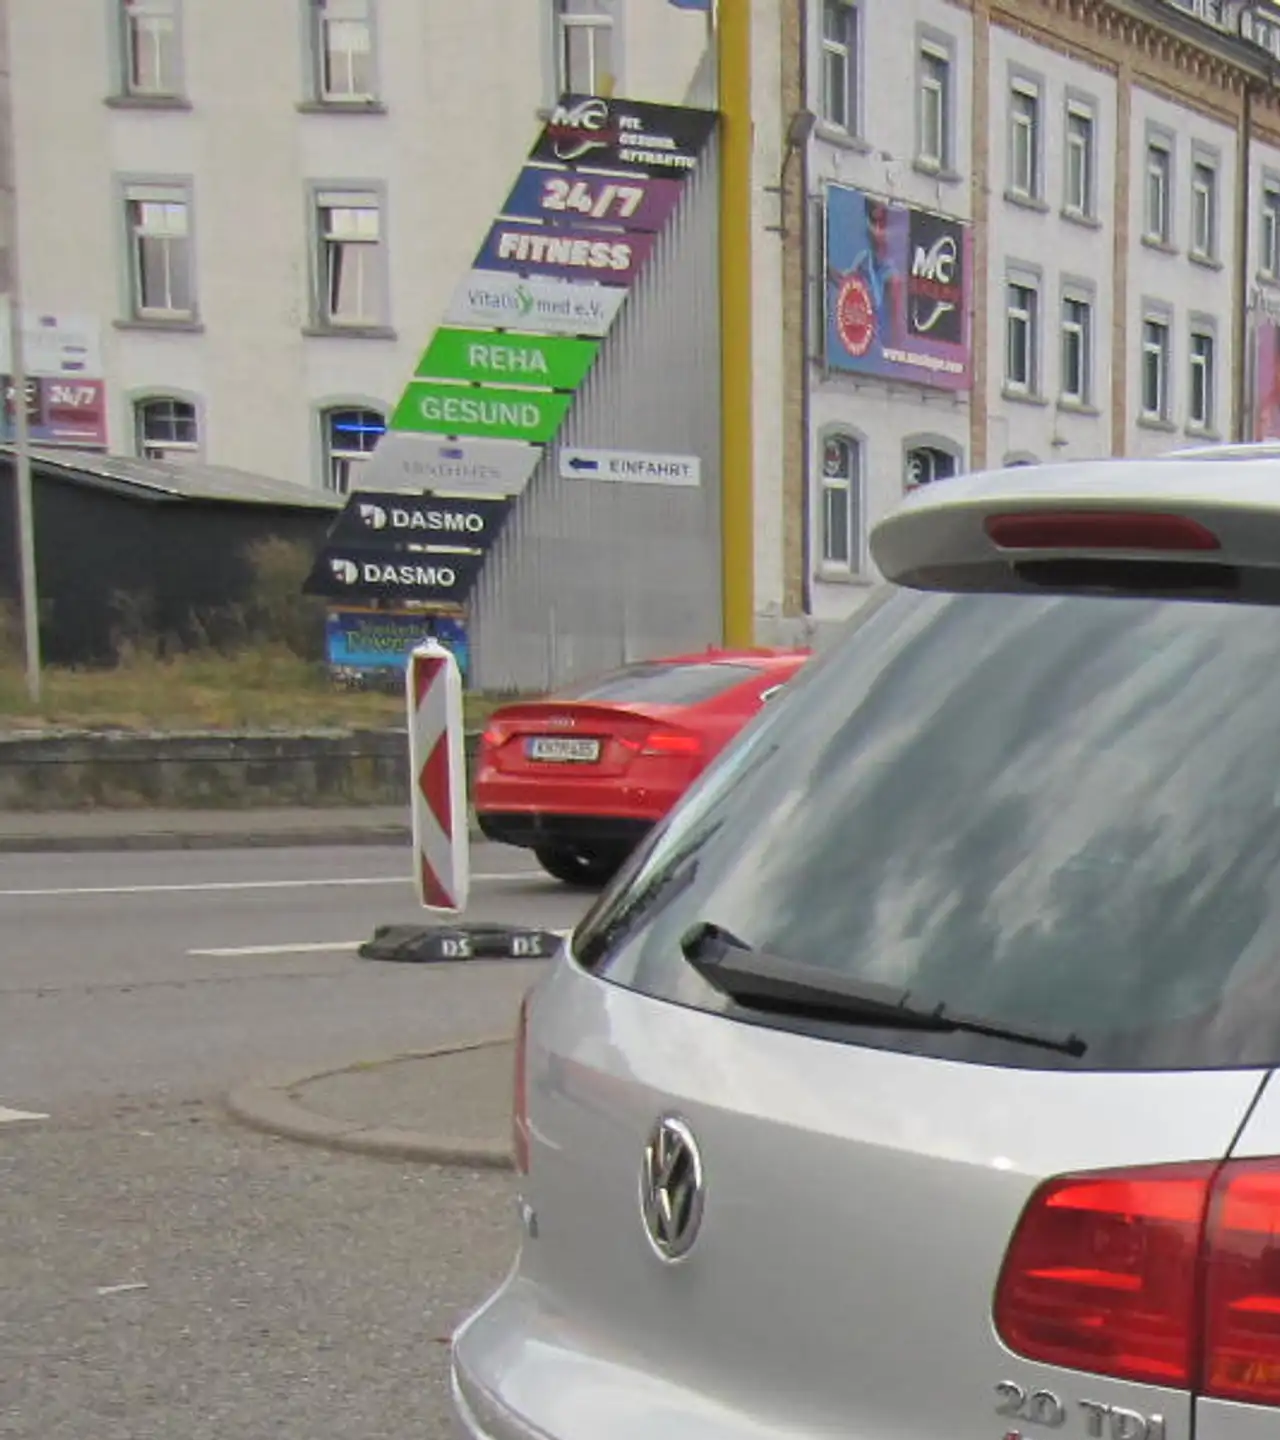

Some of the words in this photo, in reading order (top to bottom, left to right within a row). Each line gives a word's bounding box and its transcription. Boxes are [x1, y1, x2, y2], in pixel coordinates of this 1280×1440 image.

[542, 178, 644, 219] 24/7
[498, 232, 632, 271] FITNESS
[468, 343, 549, 375] REHA
[420, 396, 541, 428] GESUND
[609, 459, 692, 477] EINFAHRT
[393, 510, 484, 533] DASMO
[364, 563, 456, 587] DASMO
